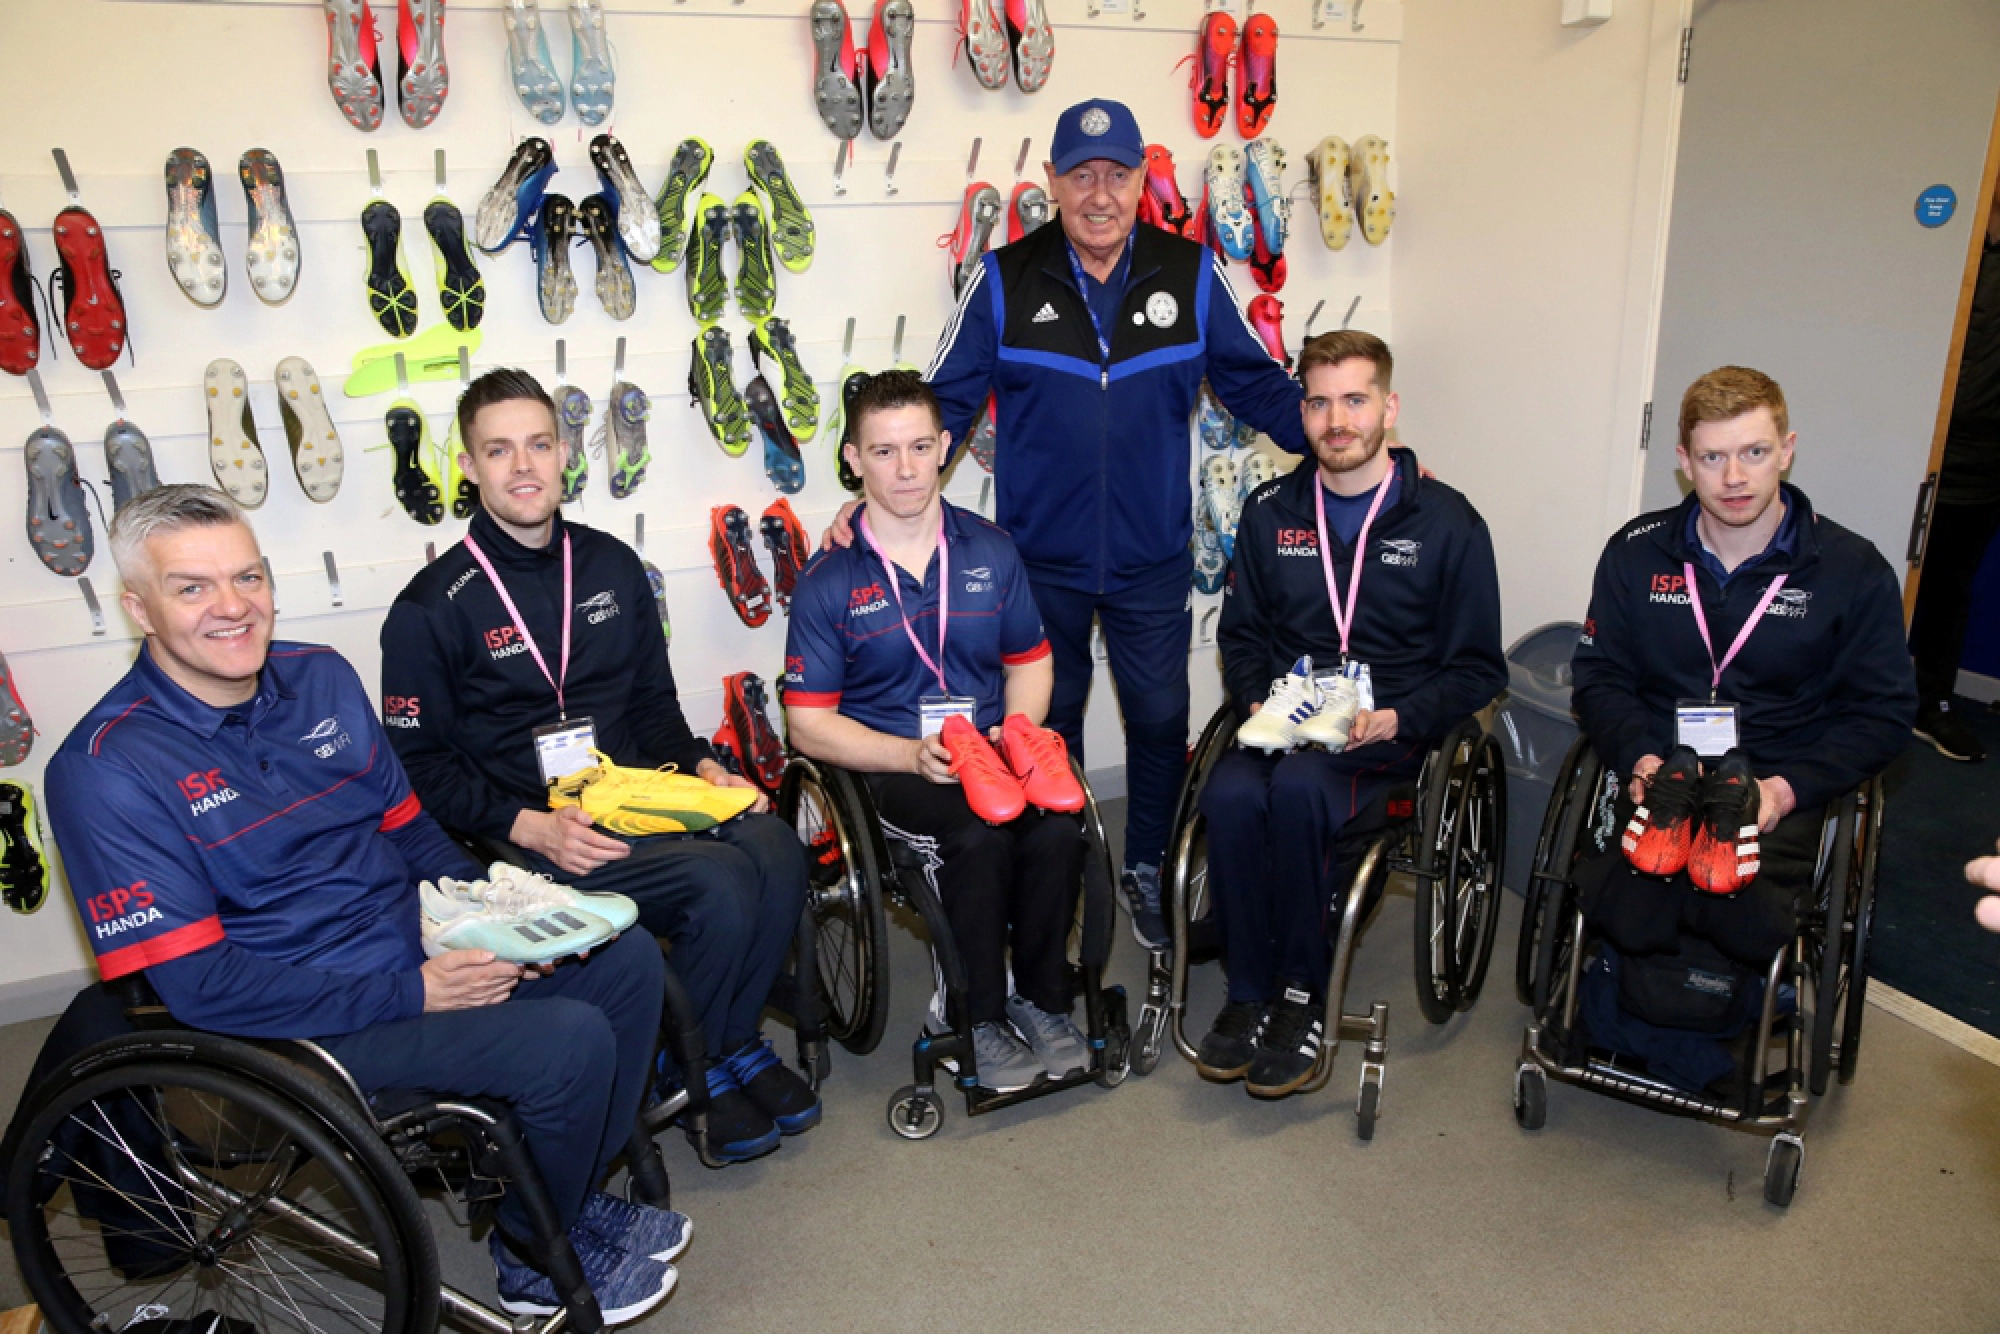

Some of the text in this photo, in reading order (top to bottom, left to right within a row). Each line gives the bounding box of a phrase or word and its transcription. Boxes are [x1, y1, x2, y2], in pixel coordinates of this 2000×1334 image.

[1277, 527, 1319, 546] ISPS
[1277, 545, 1319, 557] HANDA
[446, 567, 480, 600] AKUMA
[1651, 574, 1689, 592] ISP
[190, 786, 242, 817] HAND
[86, 880, 156, 924] ISPS
[95, 906, 165, 939] HANDA
